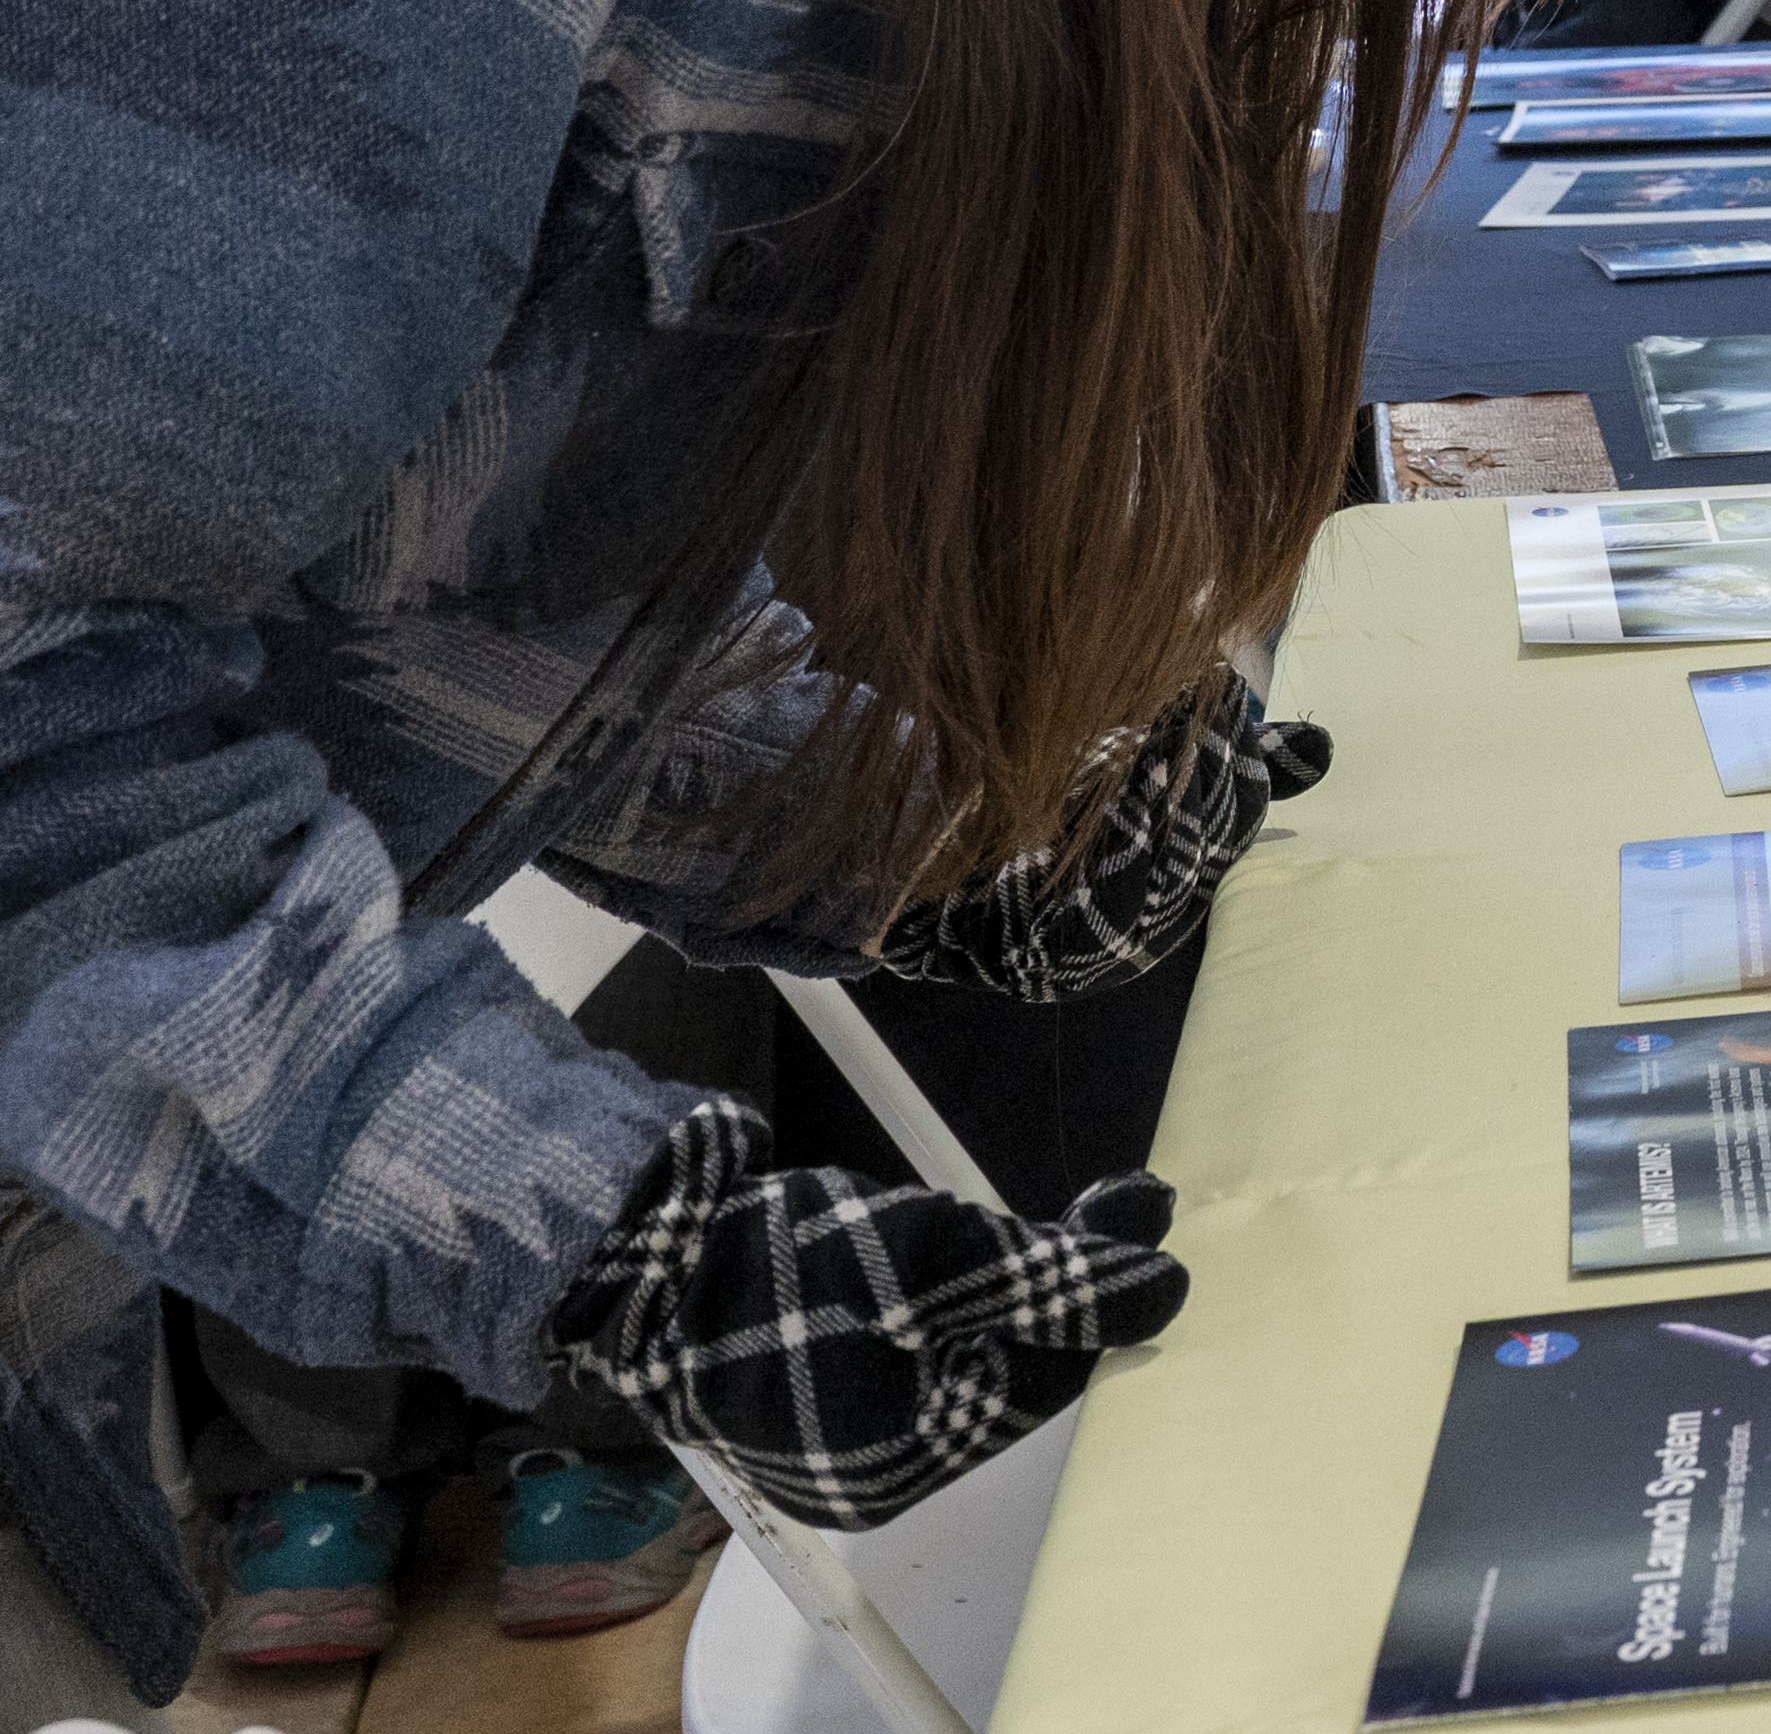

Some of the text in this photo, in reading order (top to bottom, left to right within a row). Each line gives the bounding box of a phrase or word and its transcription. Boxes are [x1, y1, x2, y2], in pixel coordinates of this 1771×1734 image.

[1638, 1142, 1679, 1248] WHAT IS ARTEMIS?
[1617, 1410, 1707, 1662] Space Launch System
